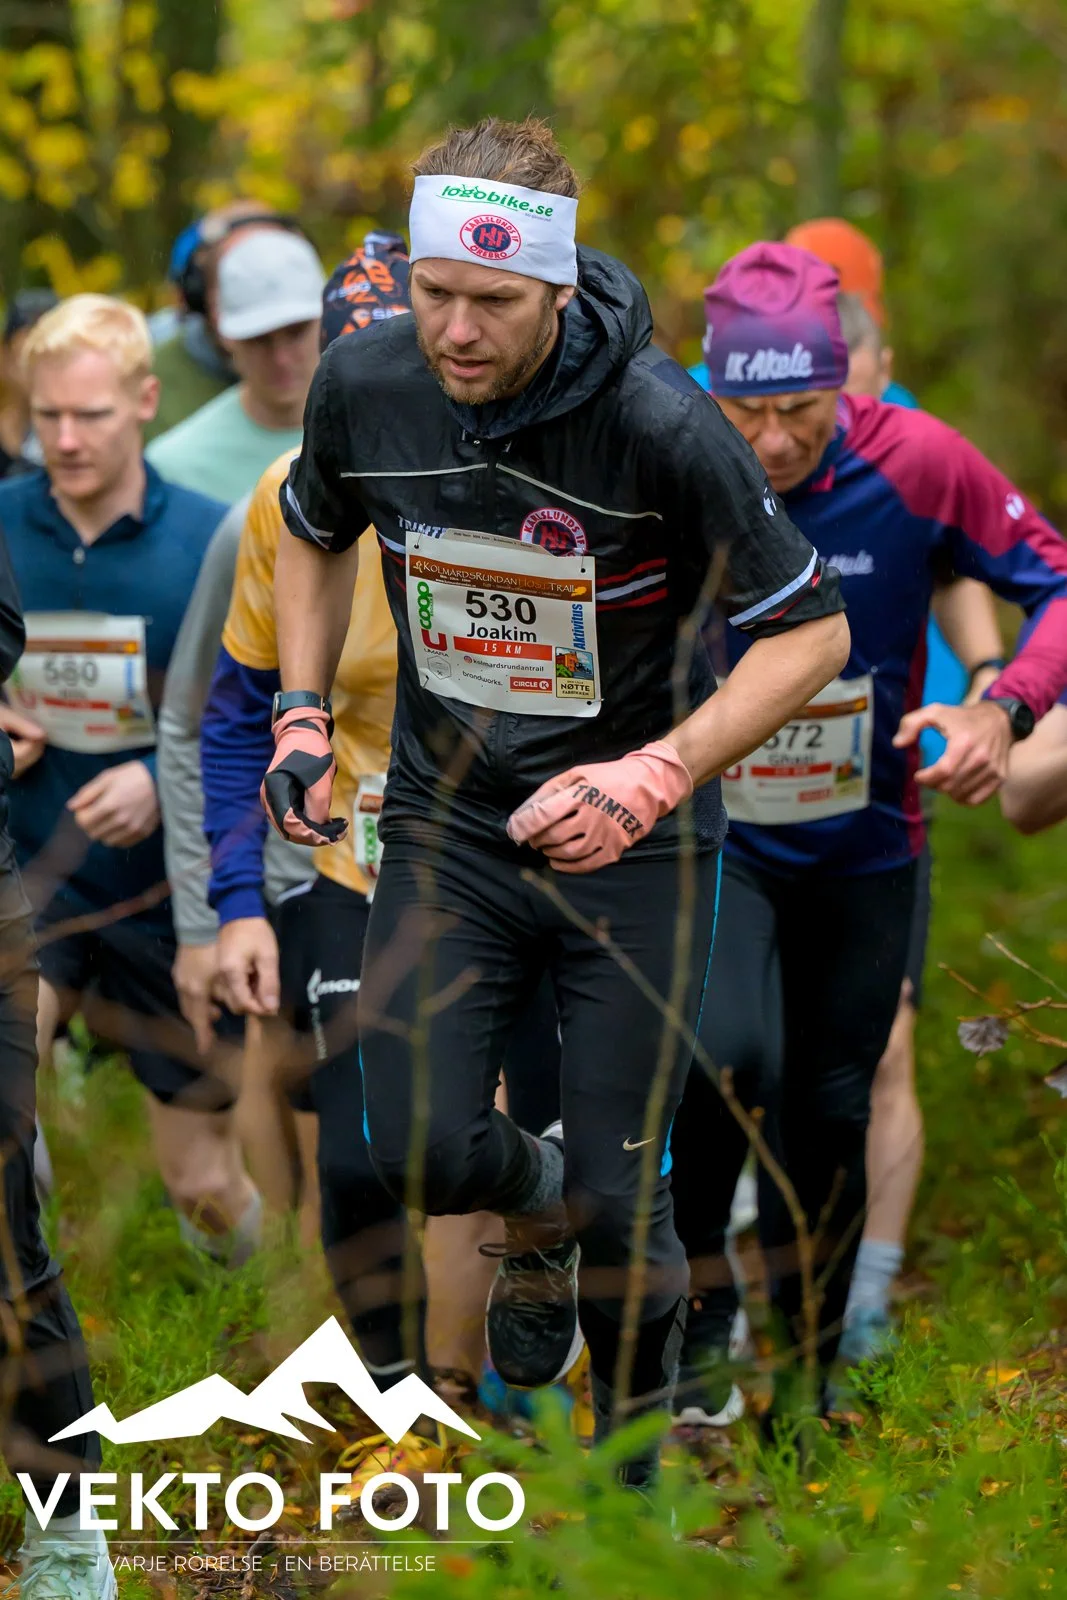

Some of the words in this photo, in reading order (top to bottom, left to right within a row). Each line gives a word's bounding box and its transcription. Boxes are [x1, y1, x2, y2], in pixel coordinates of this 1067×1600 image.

[441, 184, 553, 217] logobike.se
[464, 216, 516, 234] KARLSLUNDS
[725, 350, 750, 381] IK
[524, 510, 580, 533] KARLSLUNDS
[465, 590, 537, 625] 530
[467, 622, 537, 643] Joakim
[571, 603, 586, 650] Aktivitus
[483, 643, 497, 653] 15
[505, 644, 522, 655] KM
[513, 680, 538, 688] CIRCLE
[561, 683, 590, 692] NØTTE
[572, 784, 643, 838] TRIMTEX
